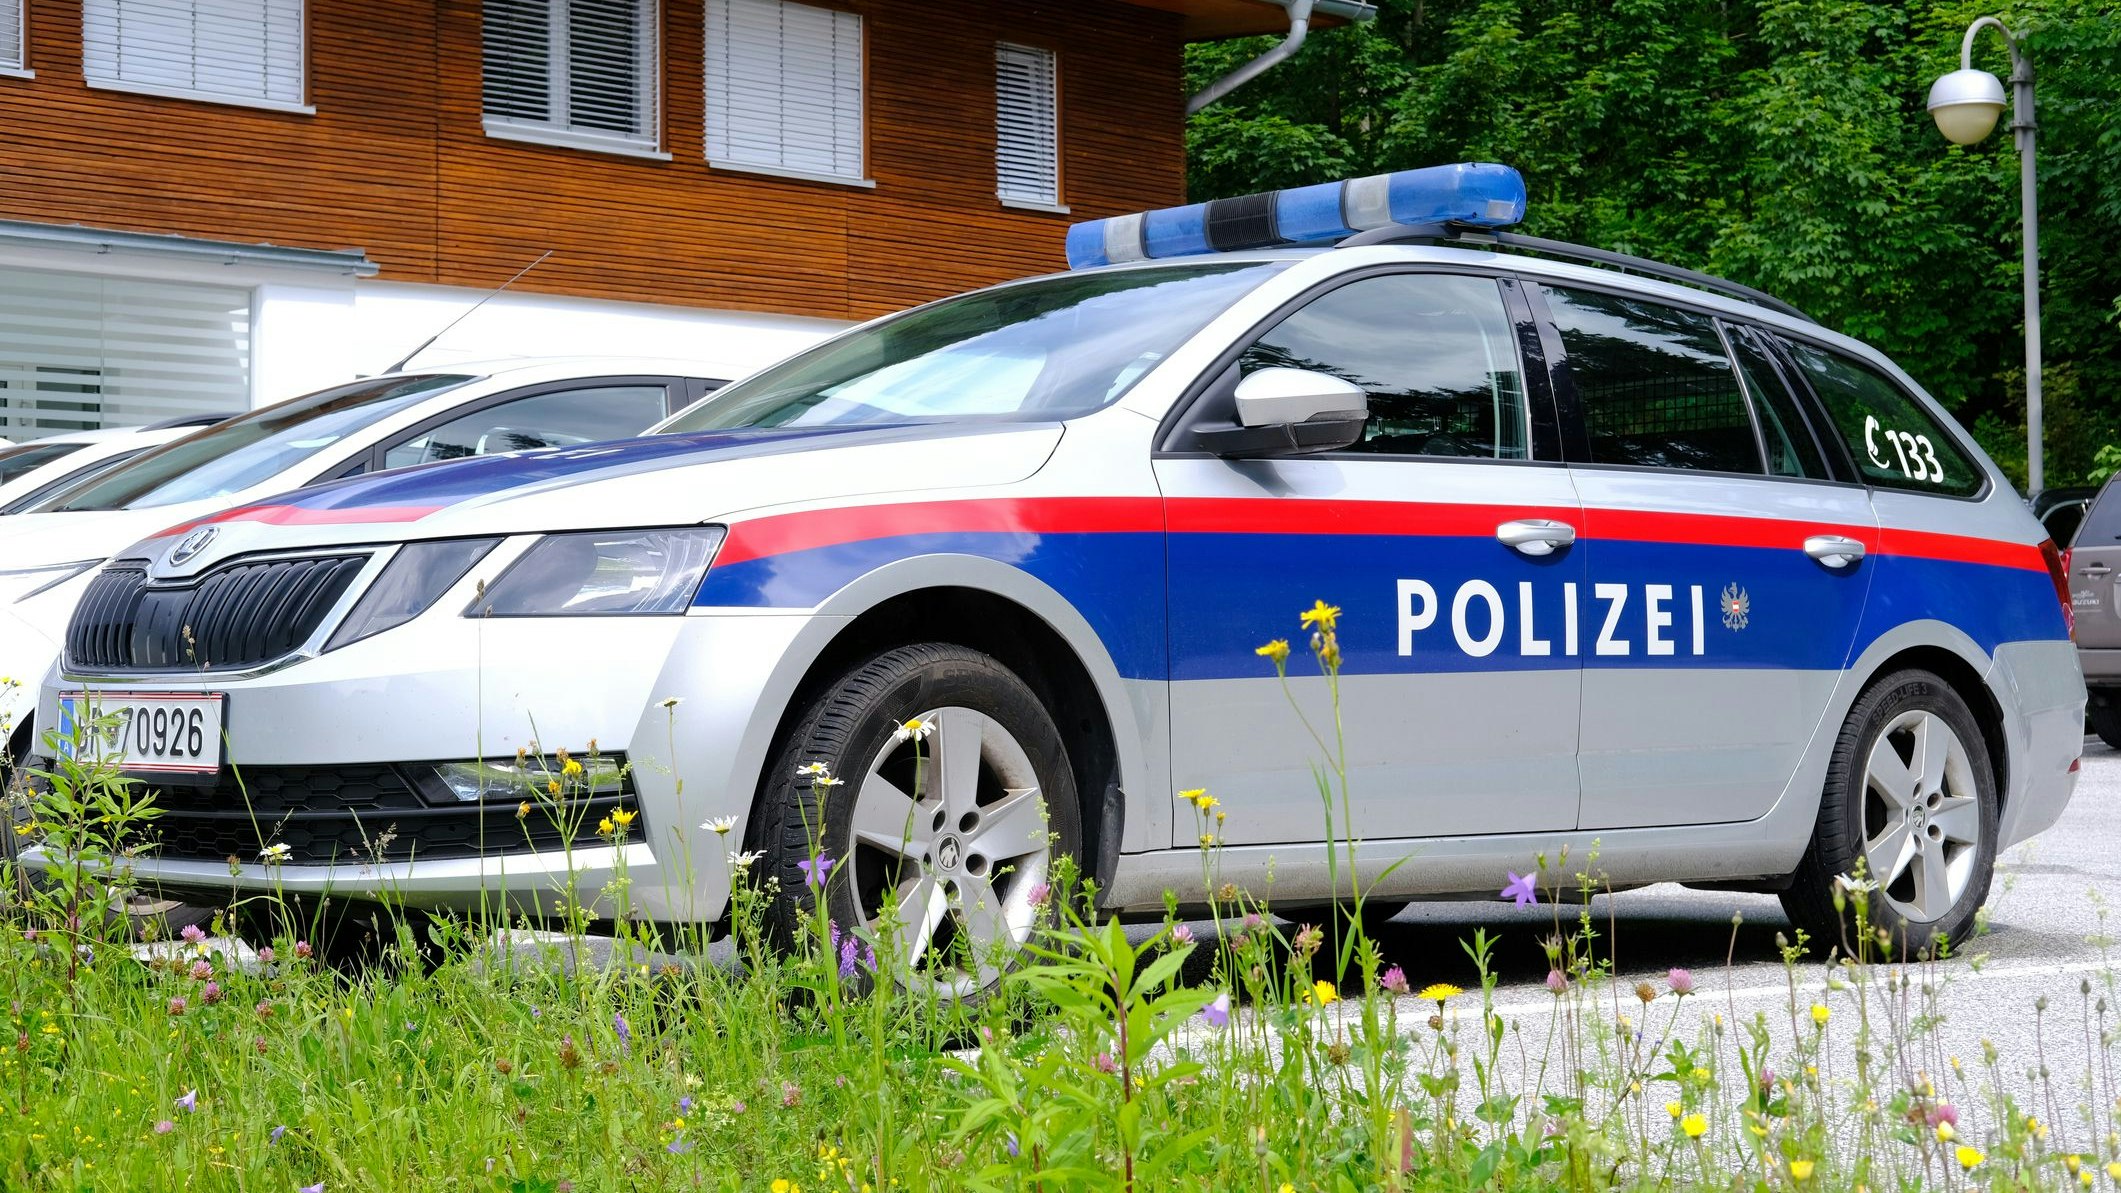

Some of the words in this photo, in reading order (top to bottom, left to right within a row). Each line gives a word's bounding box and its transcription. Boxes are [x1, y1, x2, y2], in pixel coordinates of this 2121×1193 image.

[1885, 430, 1944, 483] 133
[1397, 578, 1705, 657] POLIZEI
[121, 706, 204, 757] 70926
